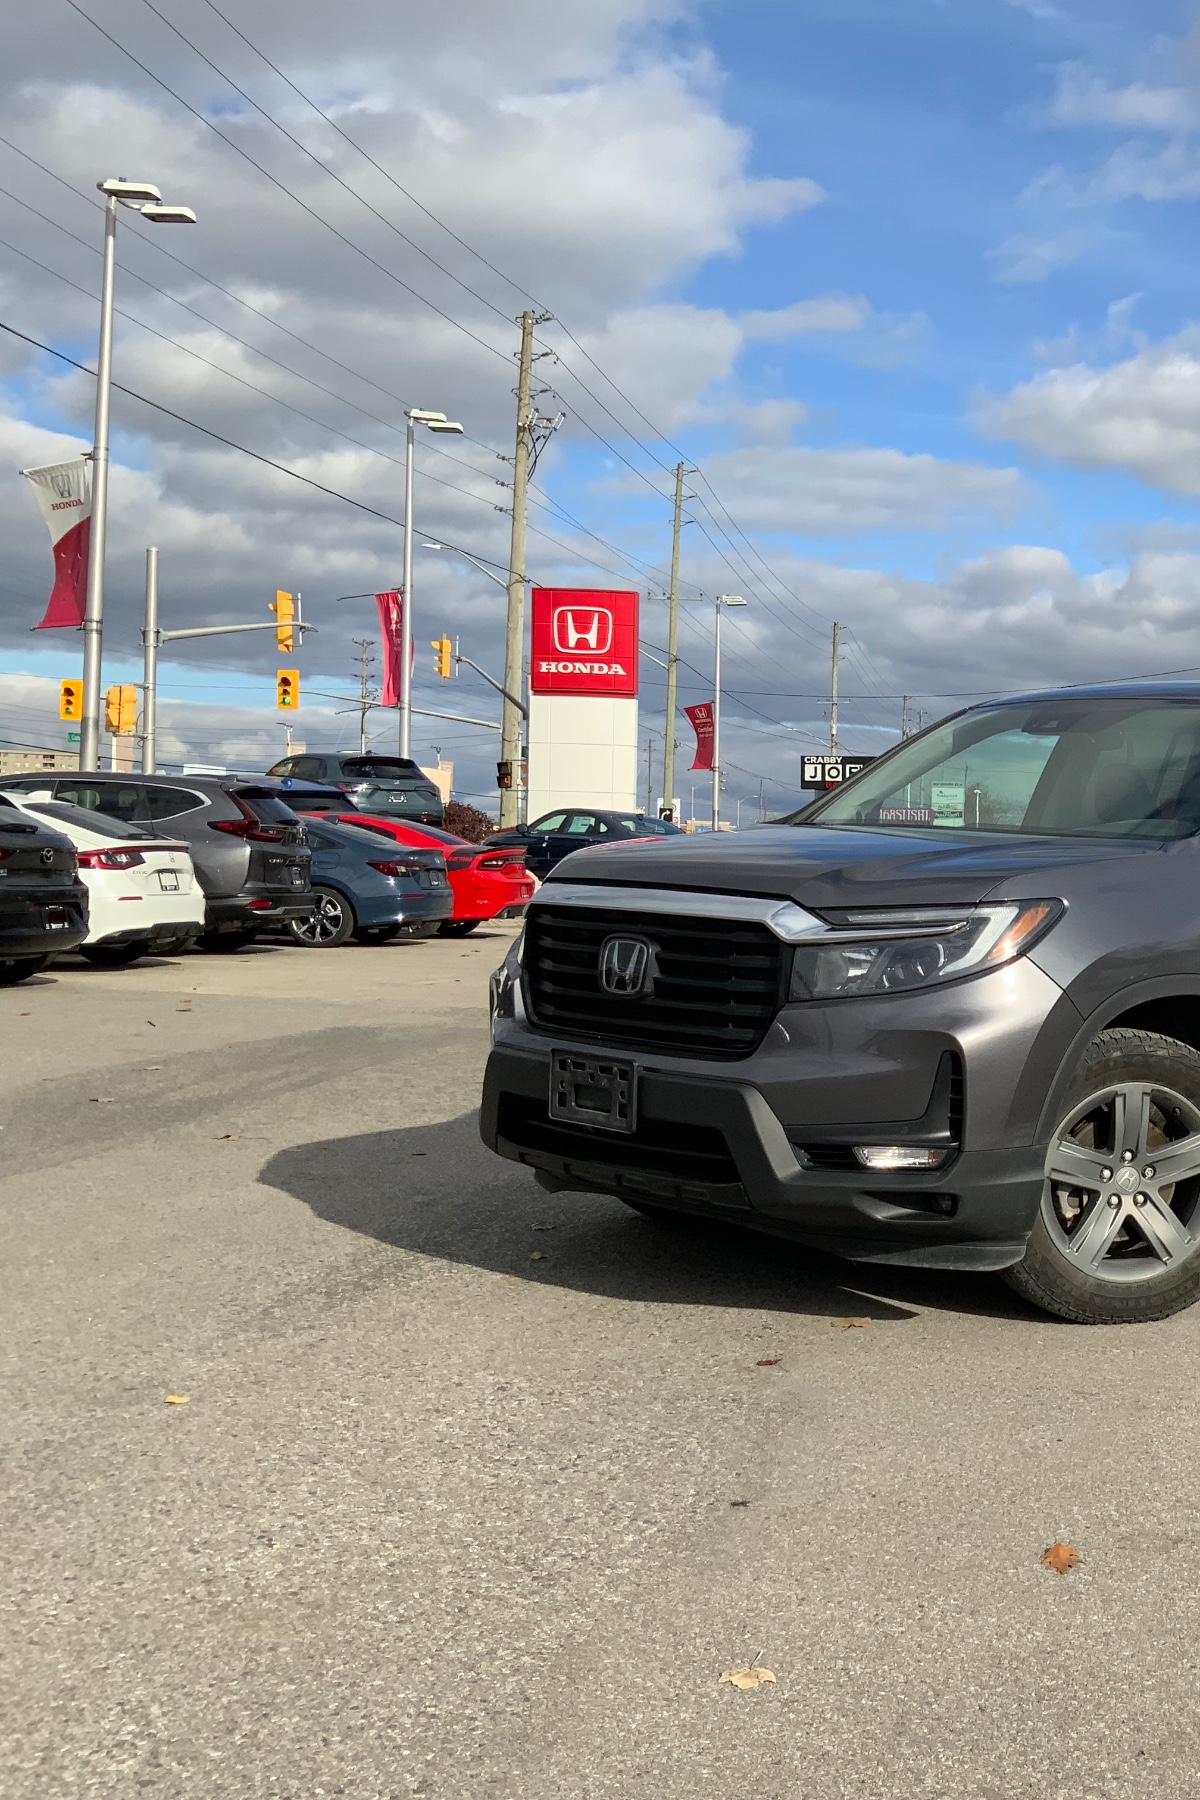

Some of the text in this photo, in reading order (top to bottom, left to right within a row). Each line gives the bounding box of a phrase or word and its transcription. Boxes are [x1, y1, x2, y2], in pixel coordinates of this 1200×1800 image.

[51, 499, 84, 511] HONDA
[539, 661, 627, 675] HONDA
[804, 756, 843, 764] CRABBY
